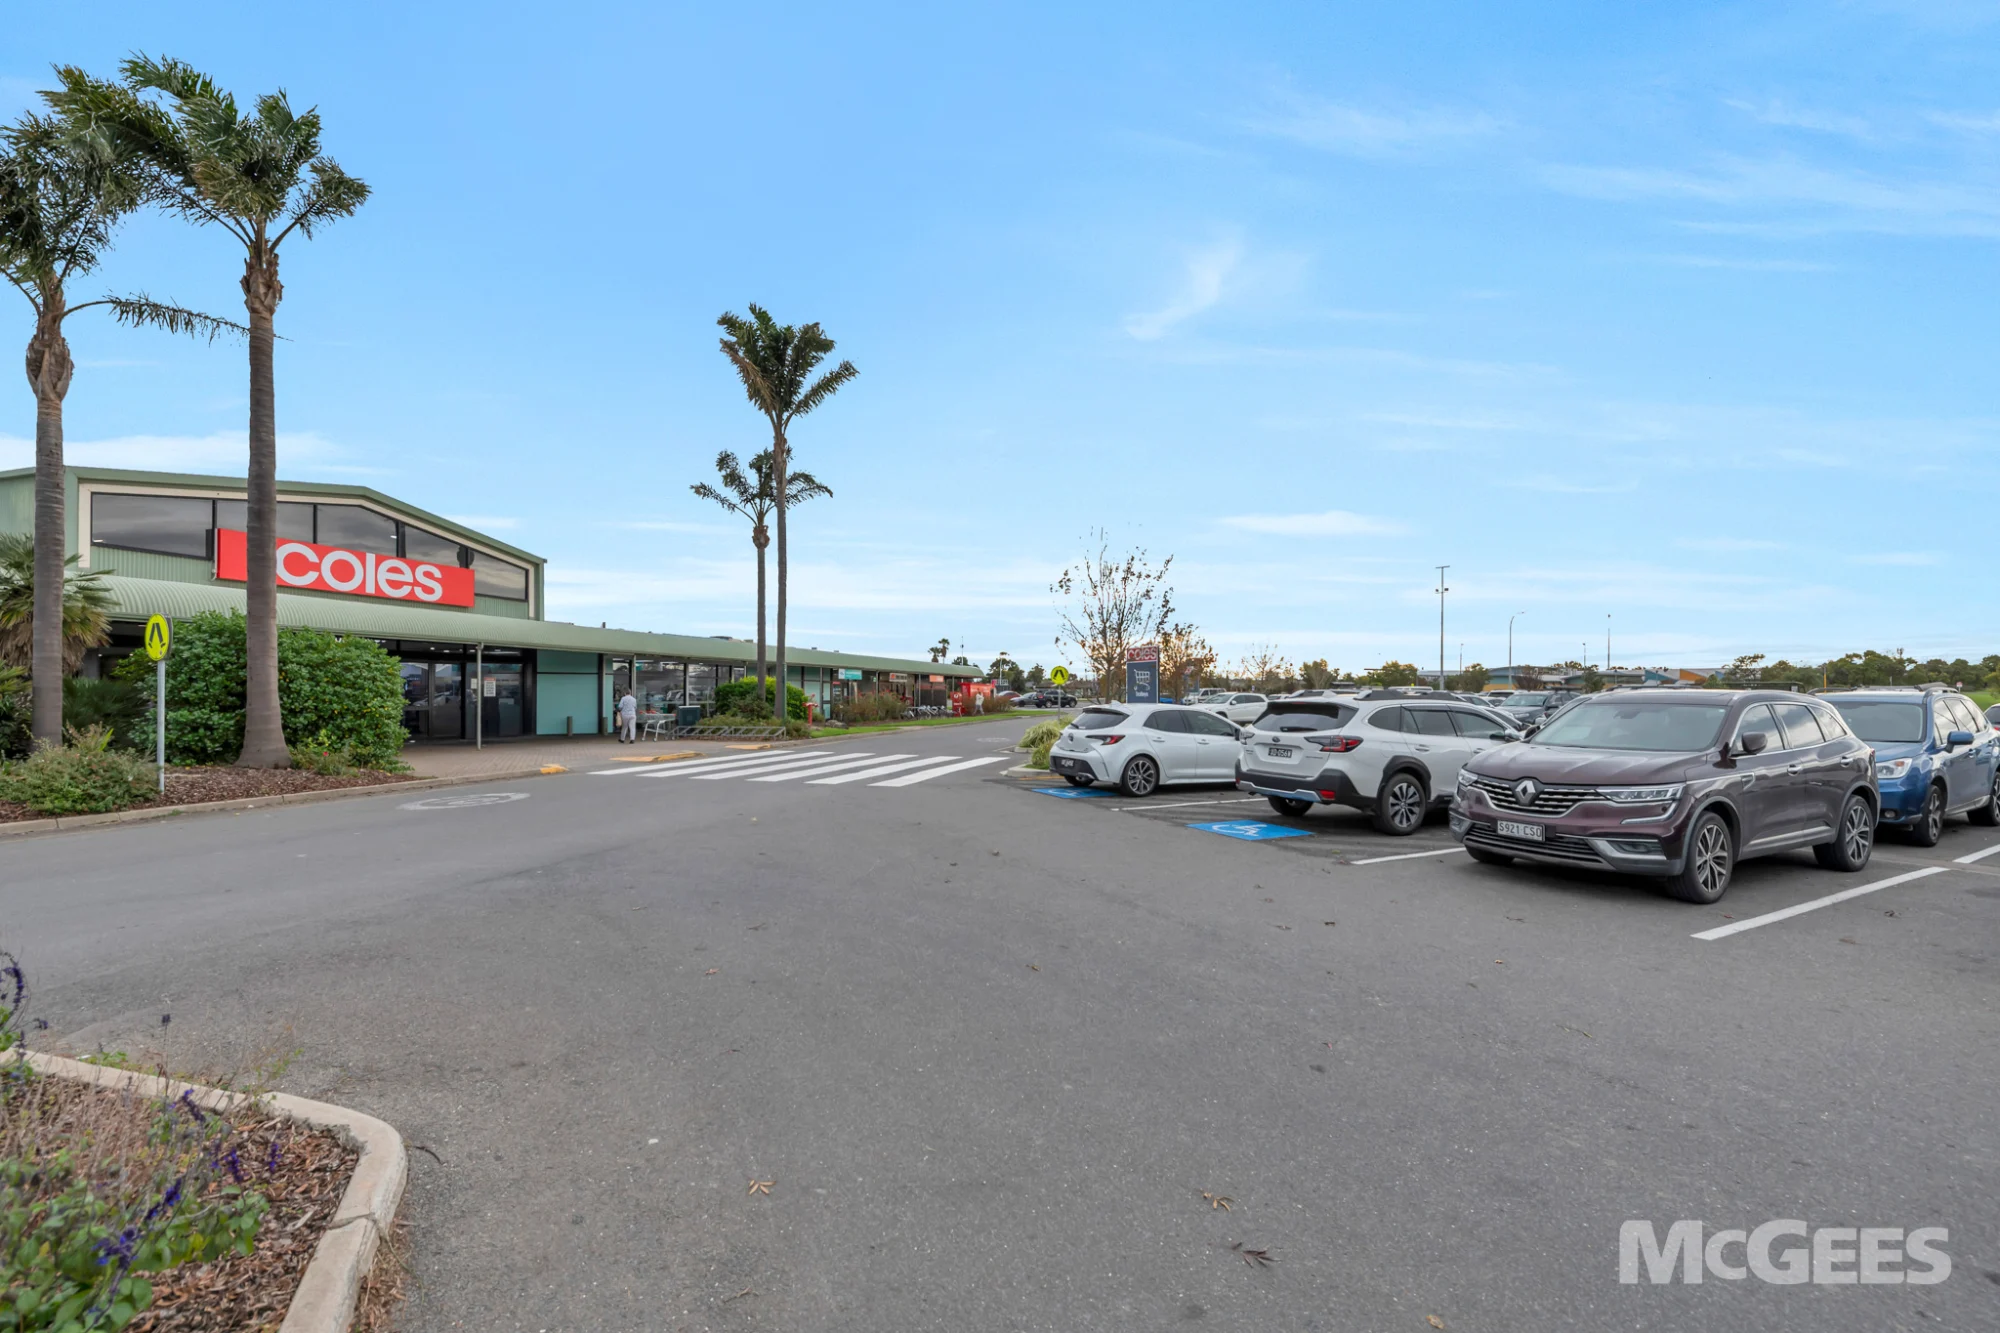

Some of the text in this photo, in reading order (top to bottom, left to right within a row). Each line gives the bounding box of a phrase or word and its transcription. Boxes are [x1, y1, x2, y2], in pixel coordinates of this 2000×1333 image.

[276, 542, 443, 602] coles
[1127, 647, 1157, 660] coles
[1499, 822, 1520, 835] S921
